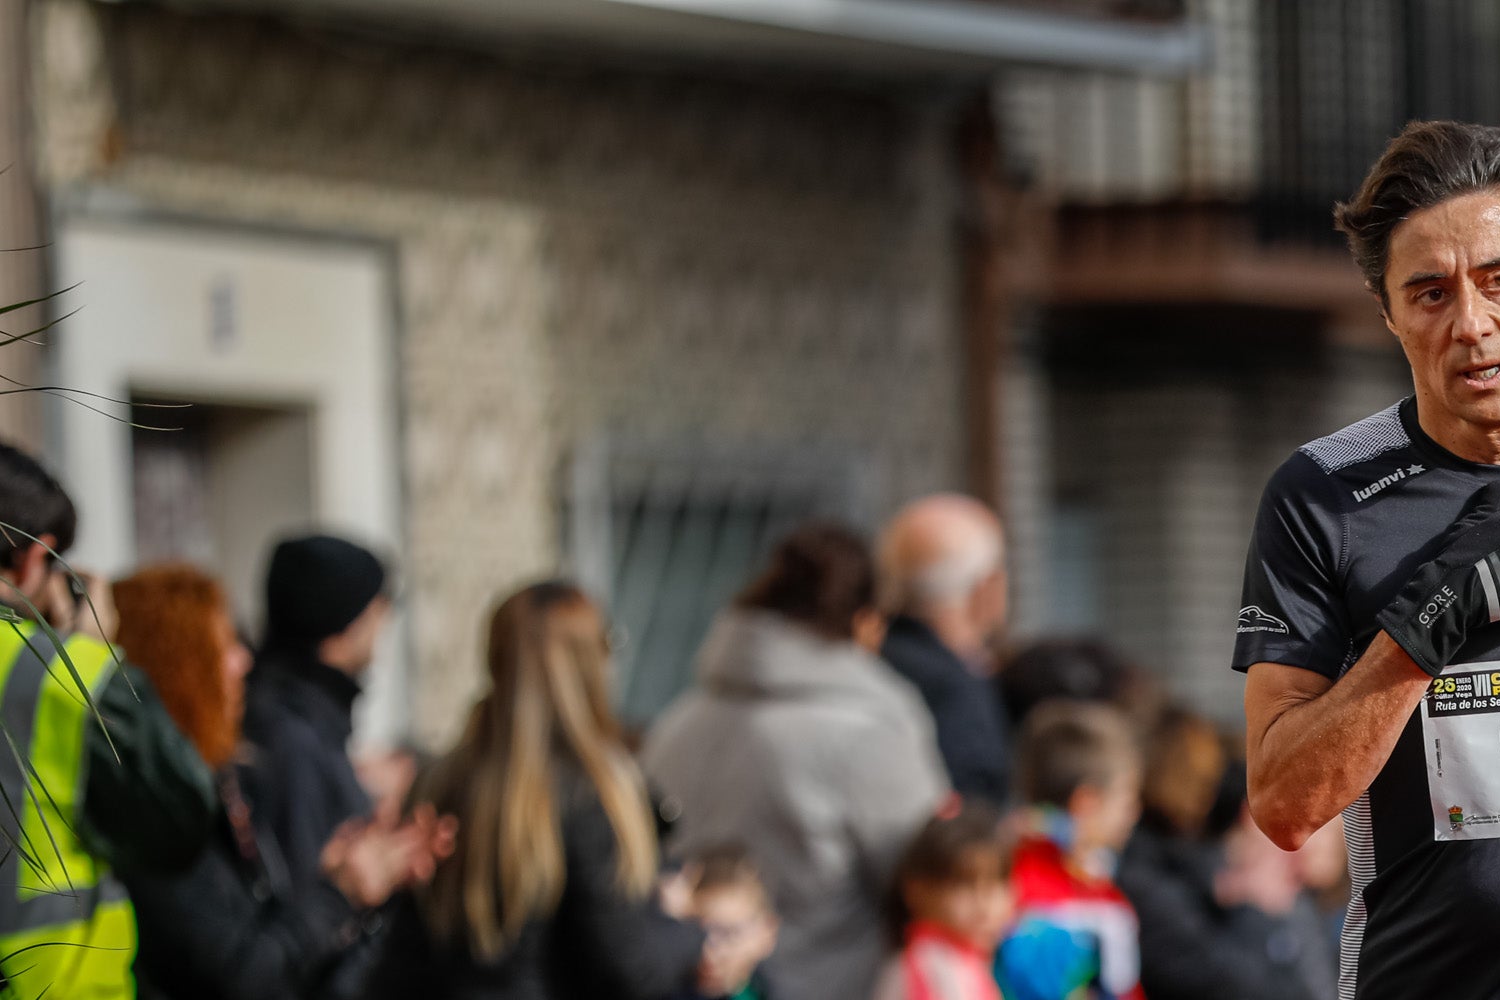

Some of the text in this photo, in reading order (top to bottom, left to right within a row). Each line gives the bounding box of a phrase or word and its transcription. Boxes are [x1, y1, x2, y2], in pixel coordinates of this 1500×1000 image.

[1352, 468, 1406, 503] luanvi
[1418, 585, 1454, 625] GORE
[1433, 677, 1456, 694] 26
[1455, 677, 1472, 685] ENERO
[1456, 684, 1472, 692] 2020
[1472, 673, 1492, 697] VII
[1435, 701, 1457, 711] Ruta
[1459, 700, 1471, 709] de
[1473, 698, 1487, 708] los
